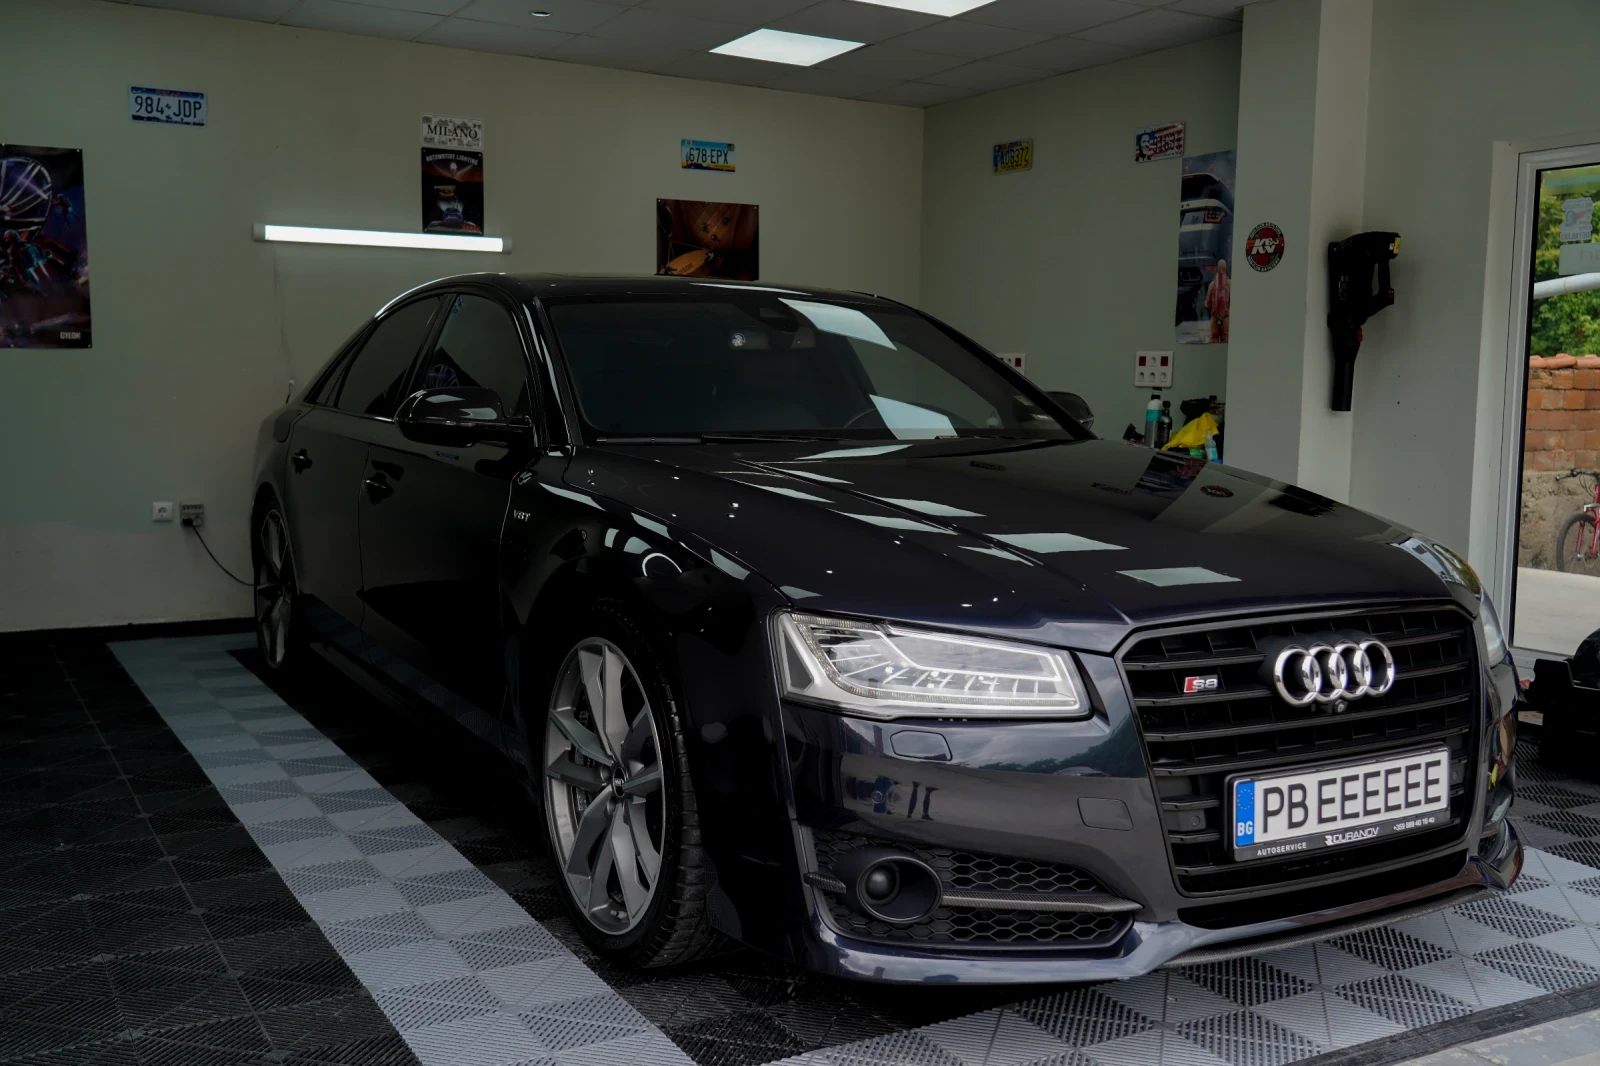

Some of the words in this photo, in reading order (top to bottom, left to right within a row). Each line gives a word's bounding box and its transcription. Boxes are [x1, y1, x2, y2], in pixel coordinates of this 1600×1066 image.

[426, 123, 479, 140] MILANO
[513, 509, 531, 522] V8T
[1191, 678, 1218, 689] S8
[1237, 820, 1254, 837] BG
[1262, 782, 1309, 834] PB
[1317, 759, 1442, 824] EEEEEE
[1256, 841, 1307, 856] AUTOSERVICE
